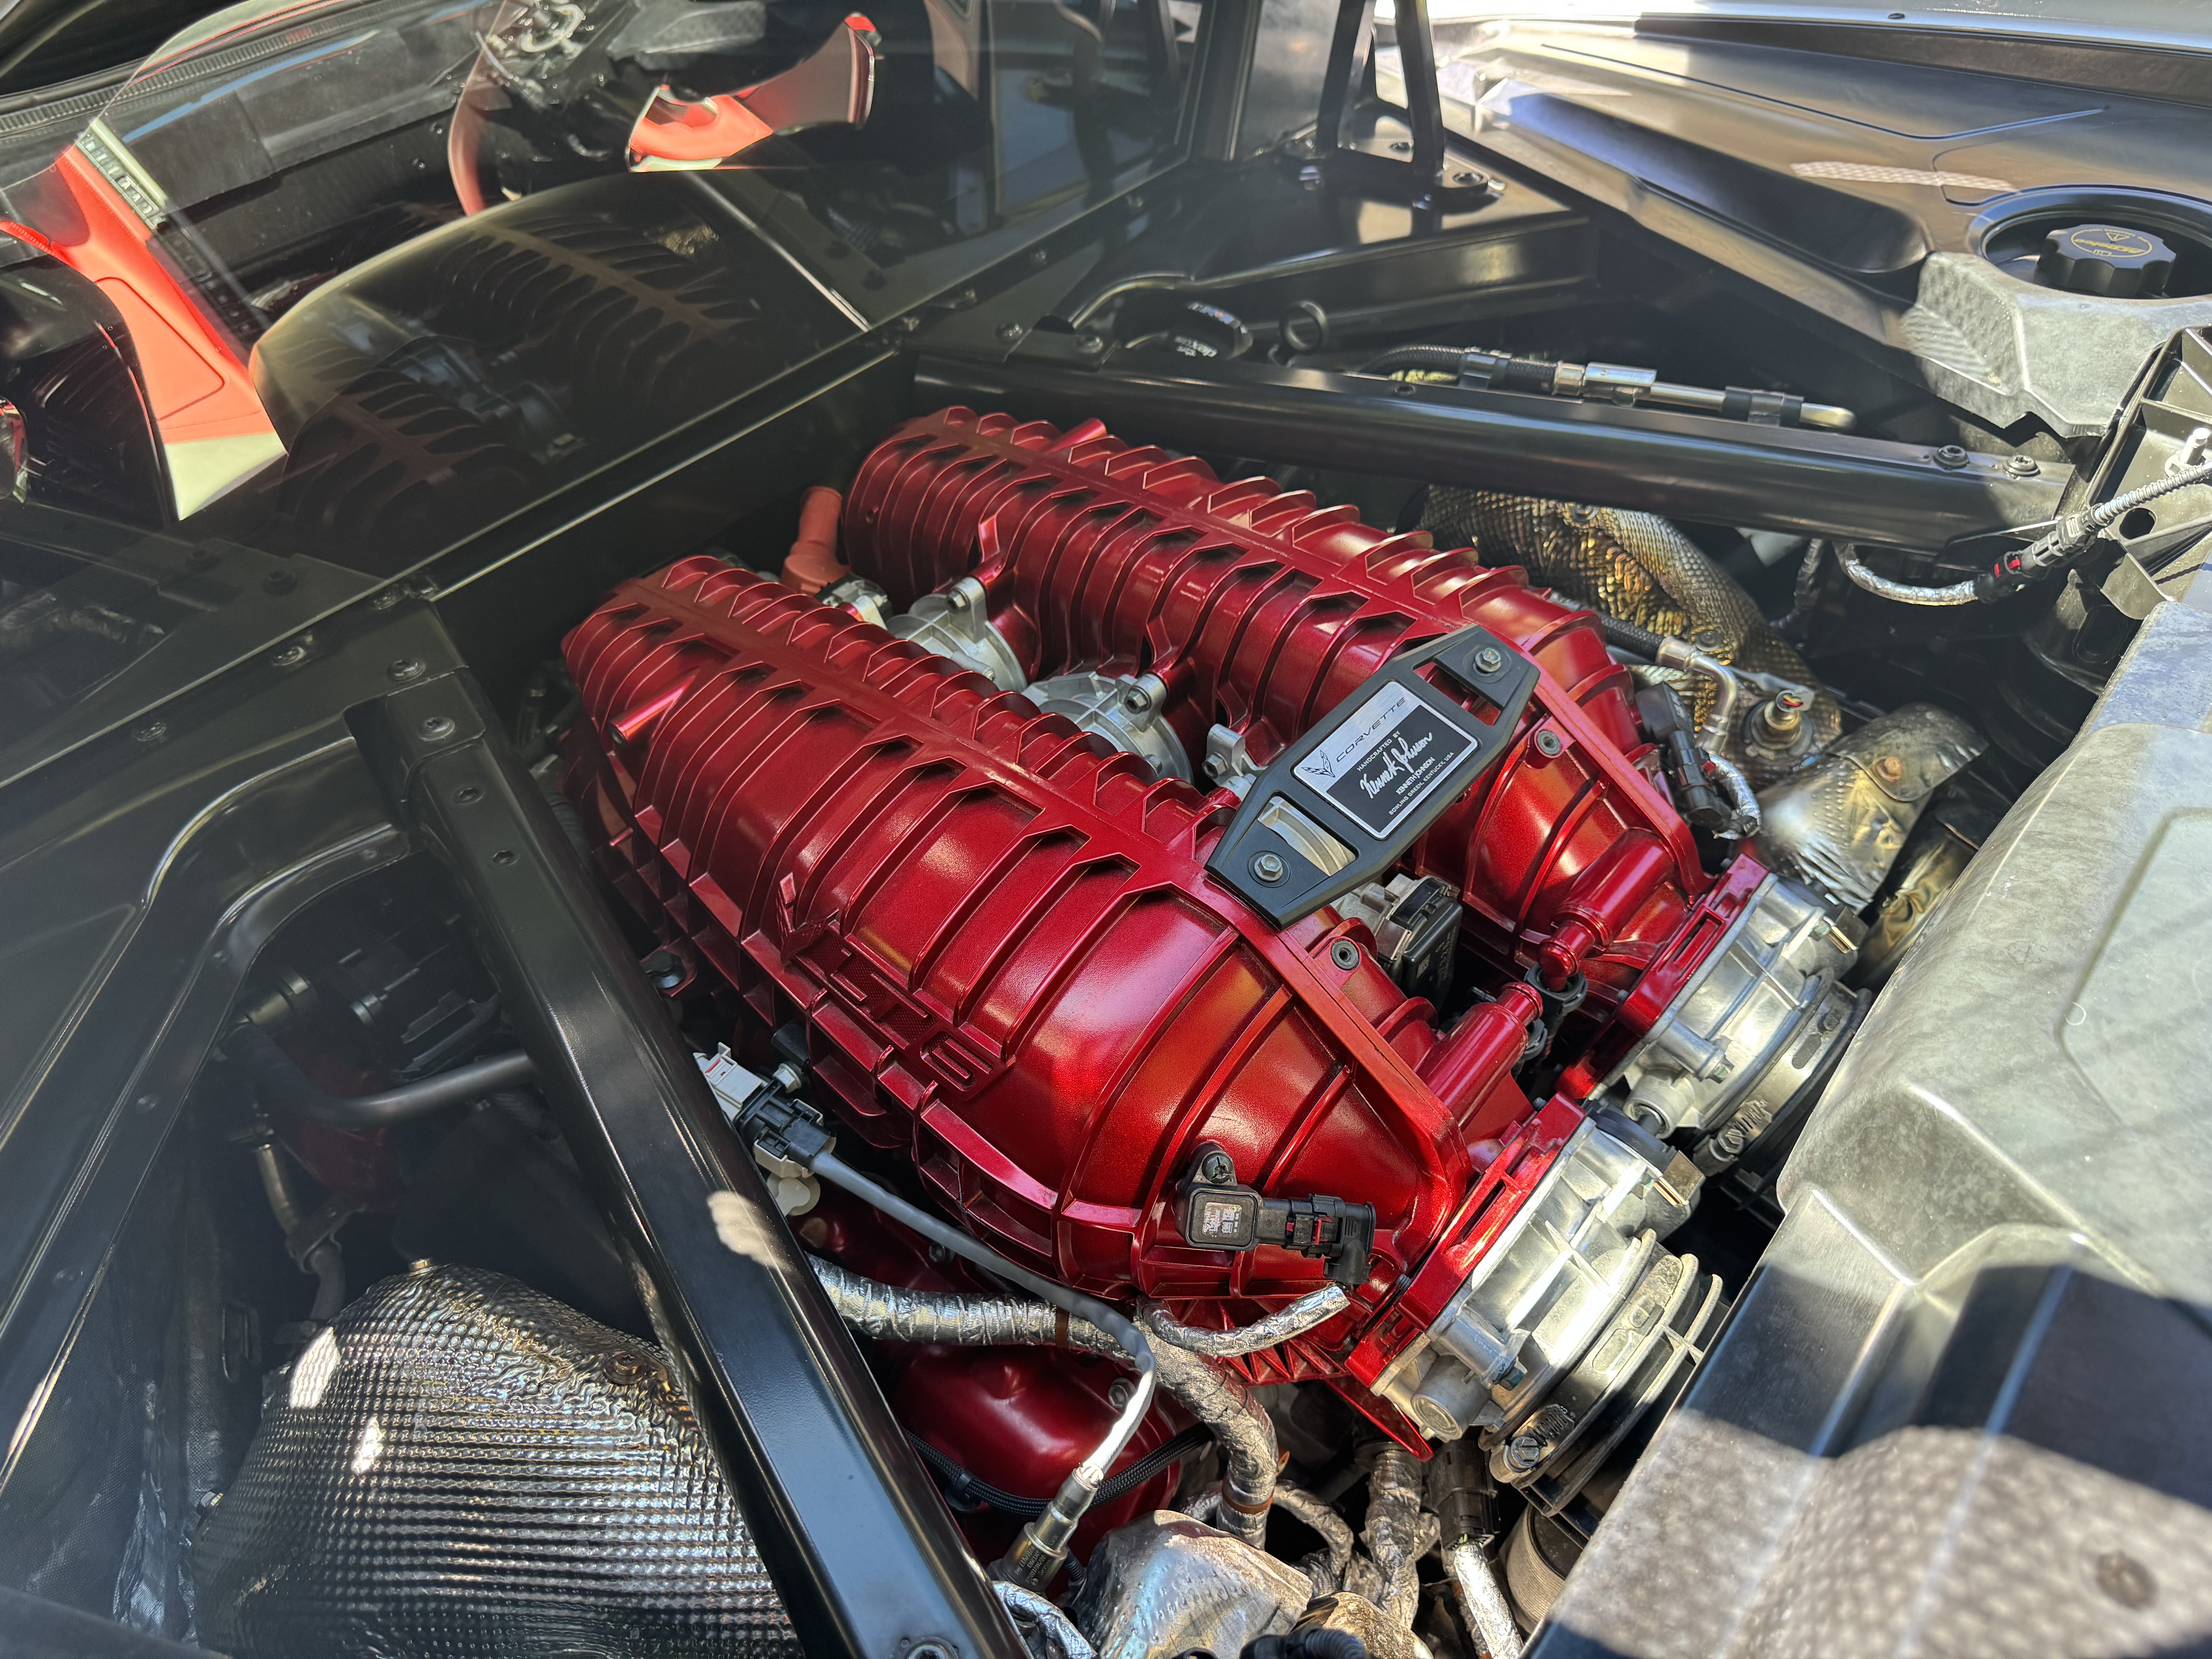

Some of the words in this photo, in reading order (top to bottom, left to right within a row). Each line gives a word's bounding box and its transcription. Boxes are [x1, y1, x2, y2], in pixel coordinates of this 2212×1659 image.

[1336, 697, 1406, 762] CORVETTE
[1357, 738, 1393, 772] HANDCRAFTED
[1393, 730, 1401, 738] BY
[1360, 752, 1405, 799] Kenneth
[1389, 796, 1409, 815] BOWLING
[1444, 752, 1455, 761] USA
[1396, 774, 1416, 795] KENNETH
[1413, 757, 1435, 778] JOHNSON
[828, 947, 994, 1092] LT6
